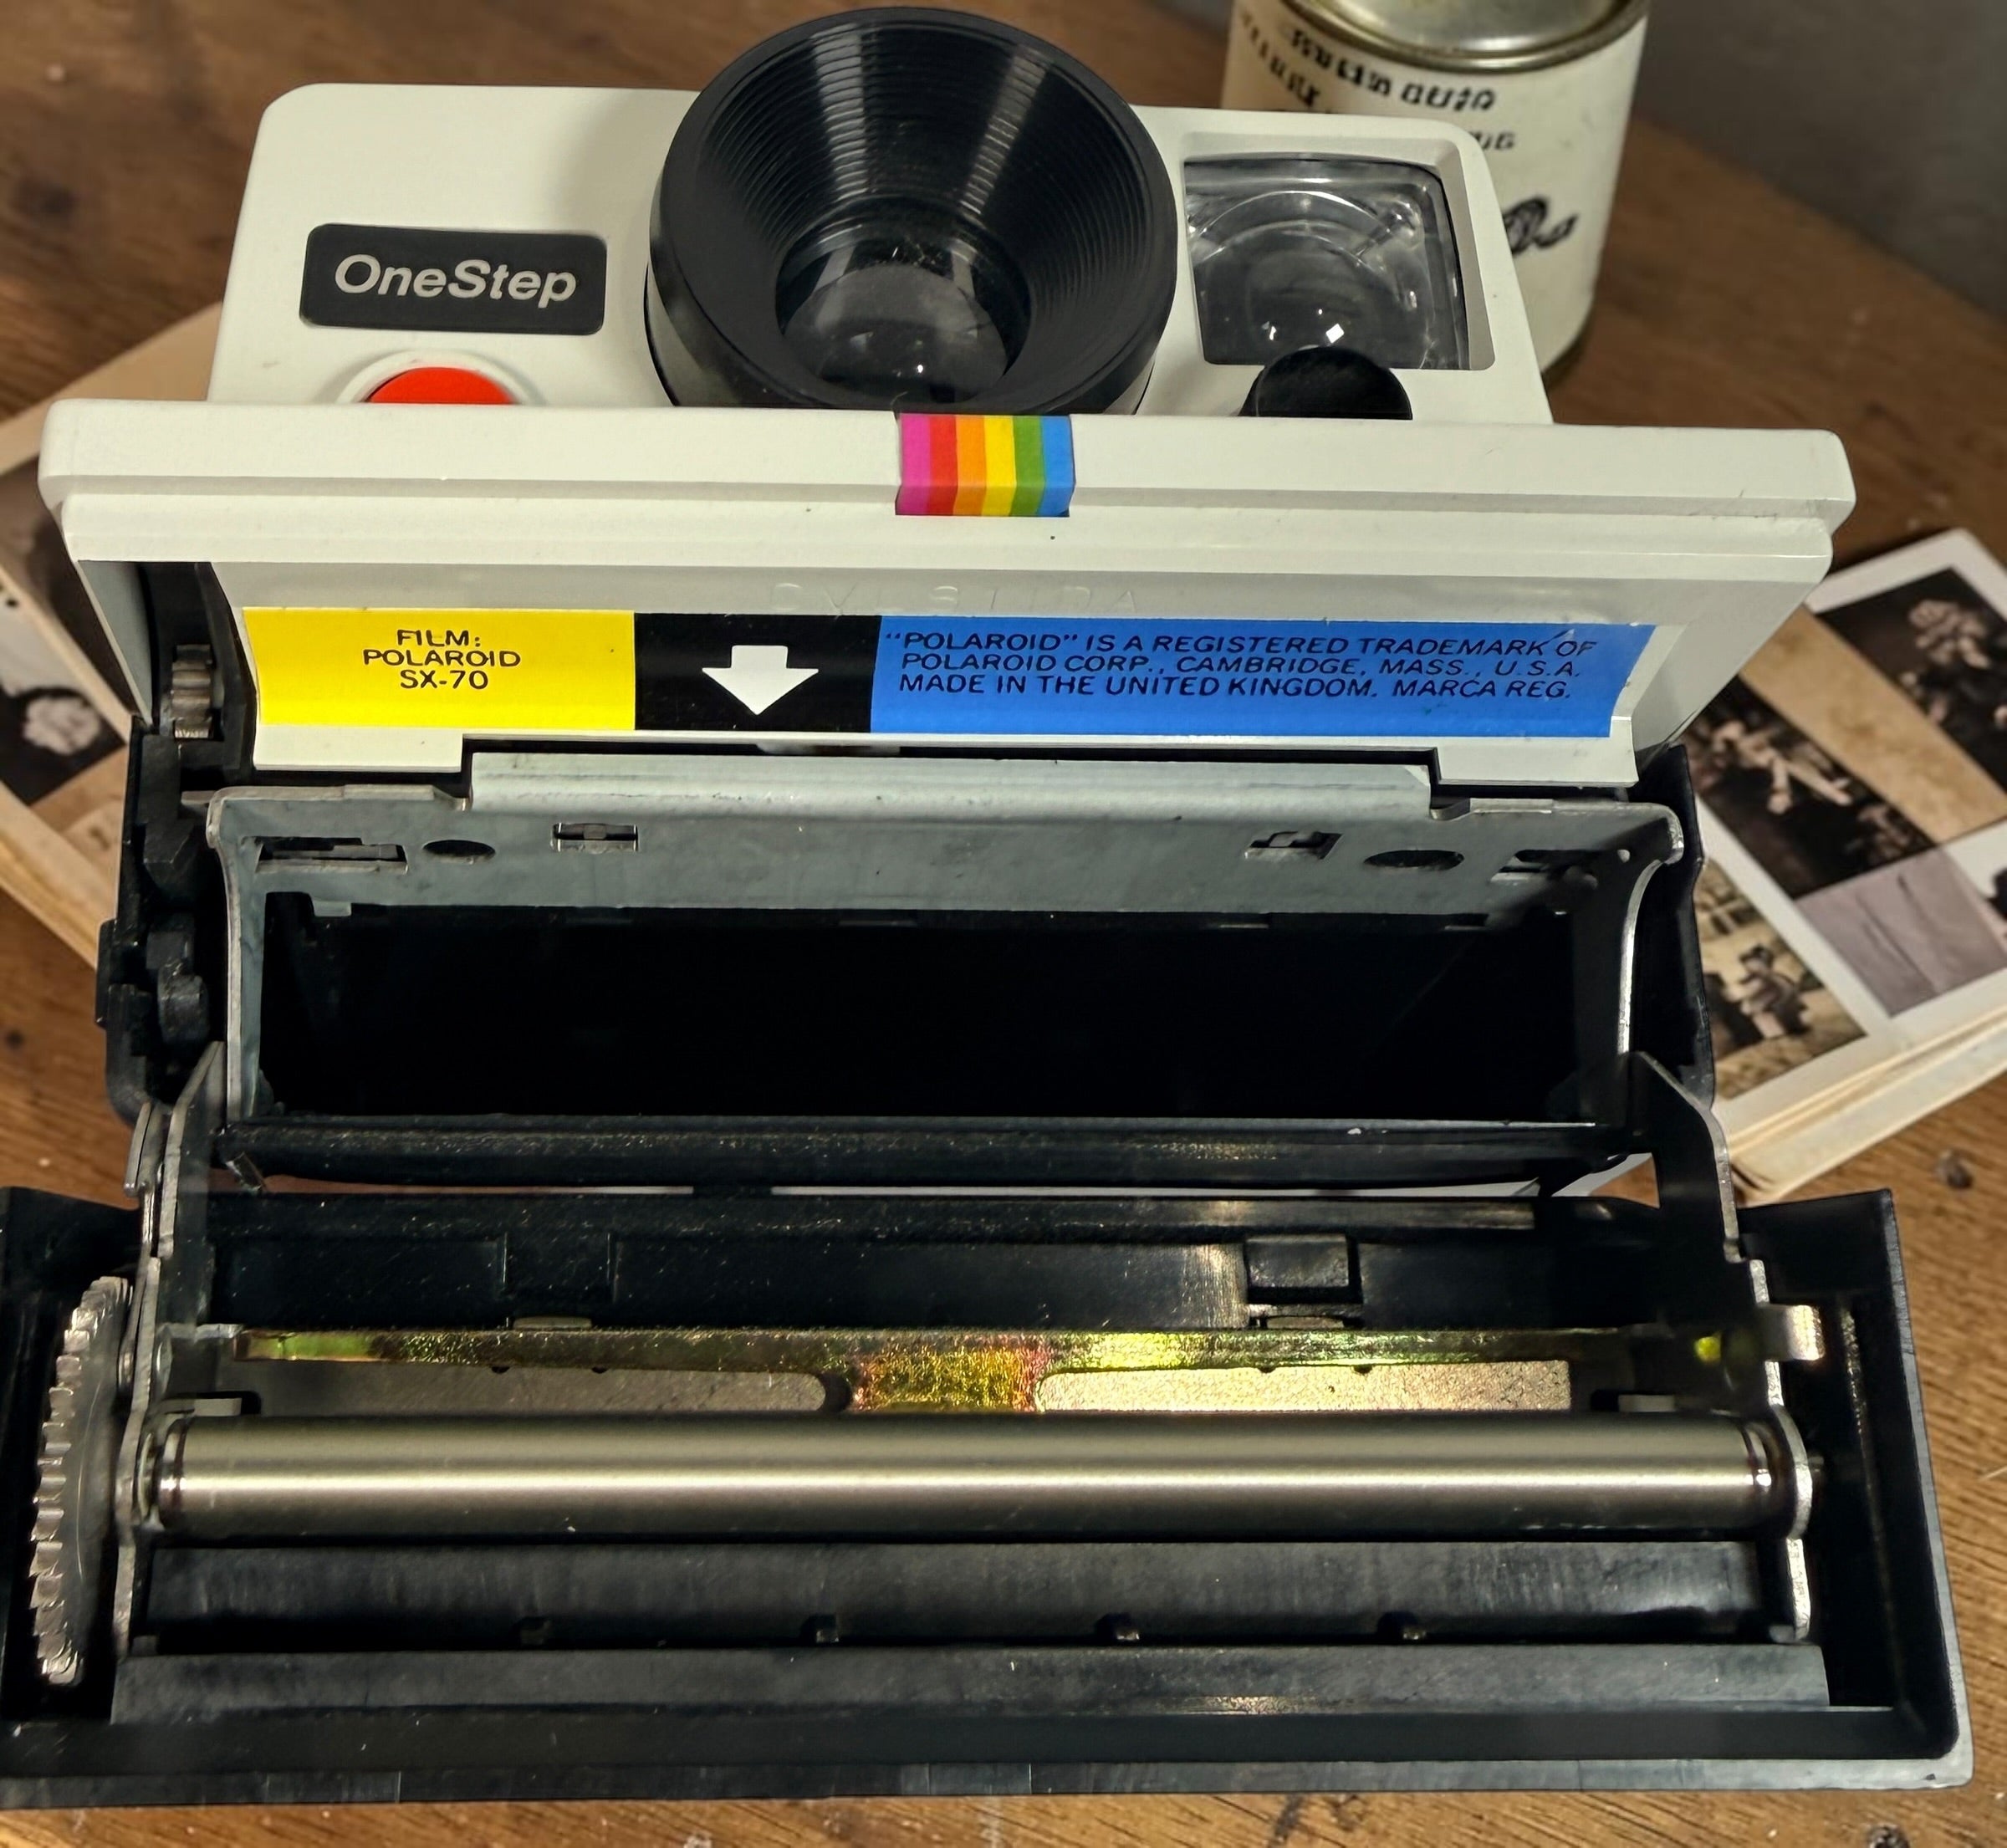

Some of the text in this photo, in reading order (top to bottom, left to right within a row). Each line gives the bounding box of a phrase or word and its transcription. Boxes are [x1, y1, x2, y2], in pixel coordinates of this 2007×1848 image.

[335, 253, 577, 309] OneStep
[396, 629, 481, 647] FILM:
[1086, 635, 1116, 652] IS
[1123, 635, 1144, 652] A
[1152, 635, 1350, 655] REGISTERED
[1358, 637, 1545, 656] TRADEMARK
[1555, 640, 1596, 656] OF
[362, 648, 521, 667] POLAROID
[901, 652, 1057, 671] POLAROID
[400, 669, 489, 690] SX-70
[899, 673, 1571, 699] MADE IN THE UNITED KINGDOM. MARCA REG.
